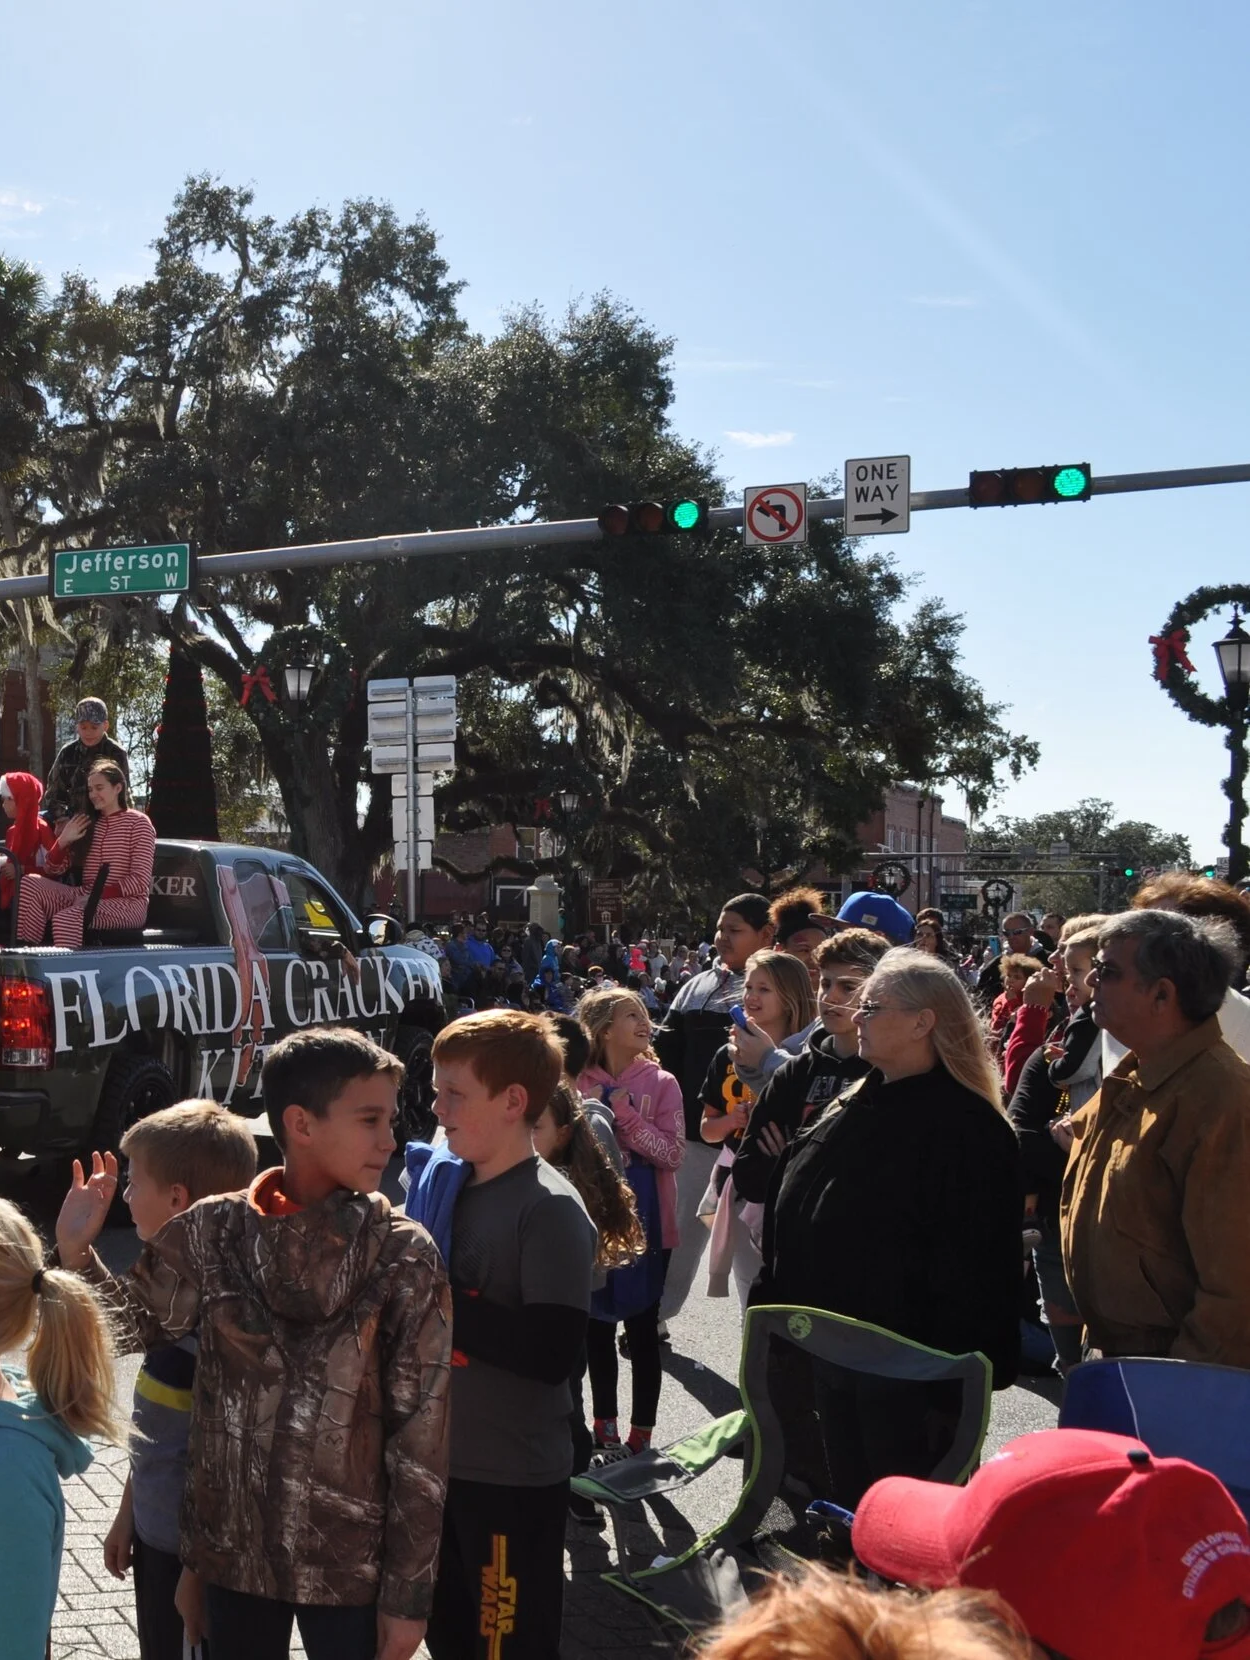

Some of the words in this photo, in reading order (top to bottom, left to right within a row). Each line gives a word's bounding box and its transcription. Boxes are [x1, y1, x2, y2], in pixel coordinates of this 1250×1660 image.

[856, 463, 897, 482] ONE
[855, 484, 899, 503] WAY
[64, 552, 179, 574] Jefferson
[63, 579, 73, 593] E
[110, 575, 131, 591] ST
[165, 572, 178, 587] W
[150, 876, 196, 897] KER
[44, 960, 275, 1053] FLORIDA
[285, 955, 444, 1027] CRACKER
